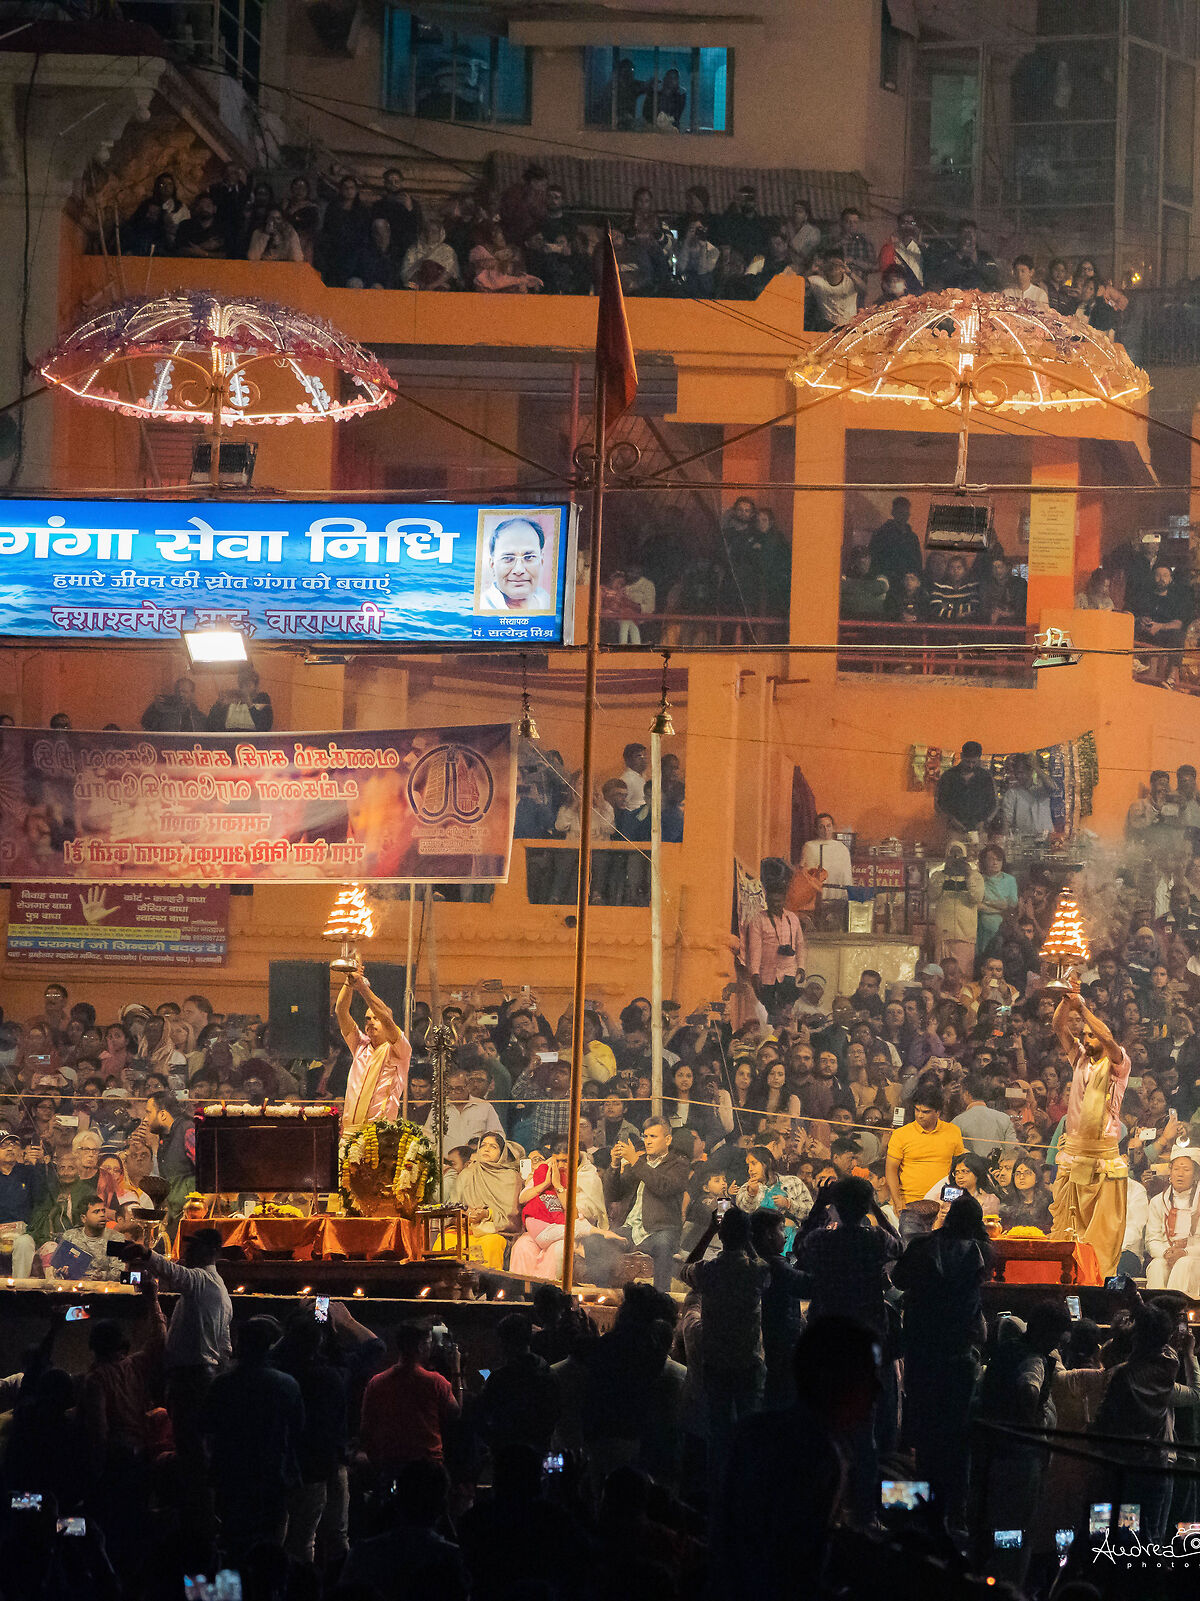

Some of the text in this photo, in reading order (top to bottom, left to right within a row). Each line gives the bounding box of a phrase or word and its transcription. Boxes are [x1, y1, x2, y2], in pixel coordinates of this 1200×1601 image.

[0, 516, 461, 563] गंगा सेवा निधि
[52, 569, 391, 595] हमारे जीवन की स्रोत गंगा को बचाएं
[51, 600, 185, 632] दशाश्वमेध
[265, 601, 385, 634] वाराणसी
[530, 627, 554, 637] मिश्र
[10, 940, 33, 948] एक
